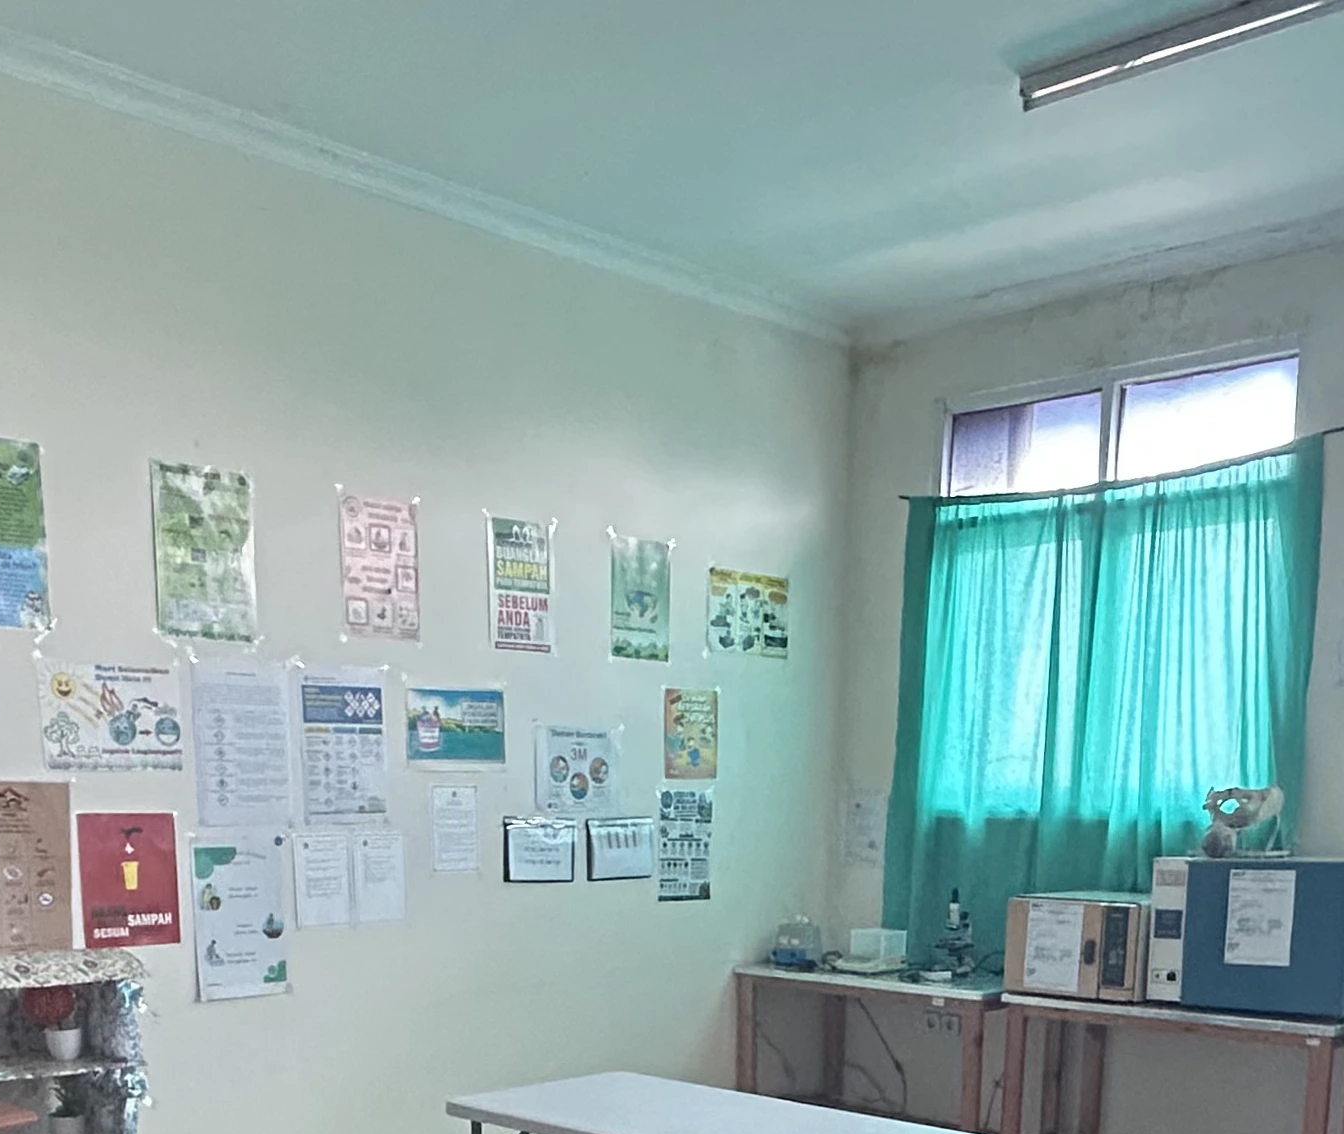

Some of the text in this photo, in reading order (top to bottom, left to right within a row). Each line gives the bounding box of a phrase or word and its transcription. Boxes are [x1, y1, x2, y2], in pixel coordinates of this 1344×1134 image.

[496, 560, 548, 580] SAMPAH
[497, 593, 548, 612] SEBELUM
[497, 610, 531, 628] ANDA
[570, 747, 588, 761] 3M
[127, 912, 173, 927] SAMPAH
